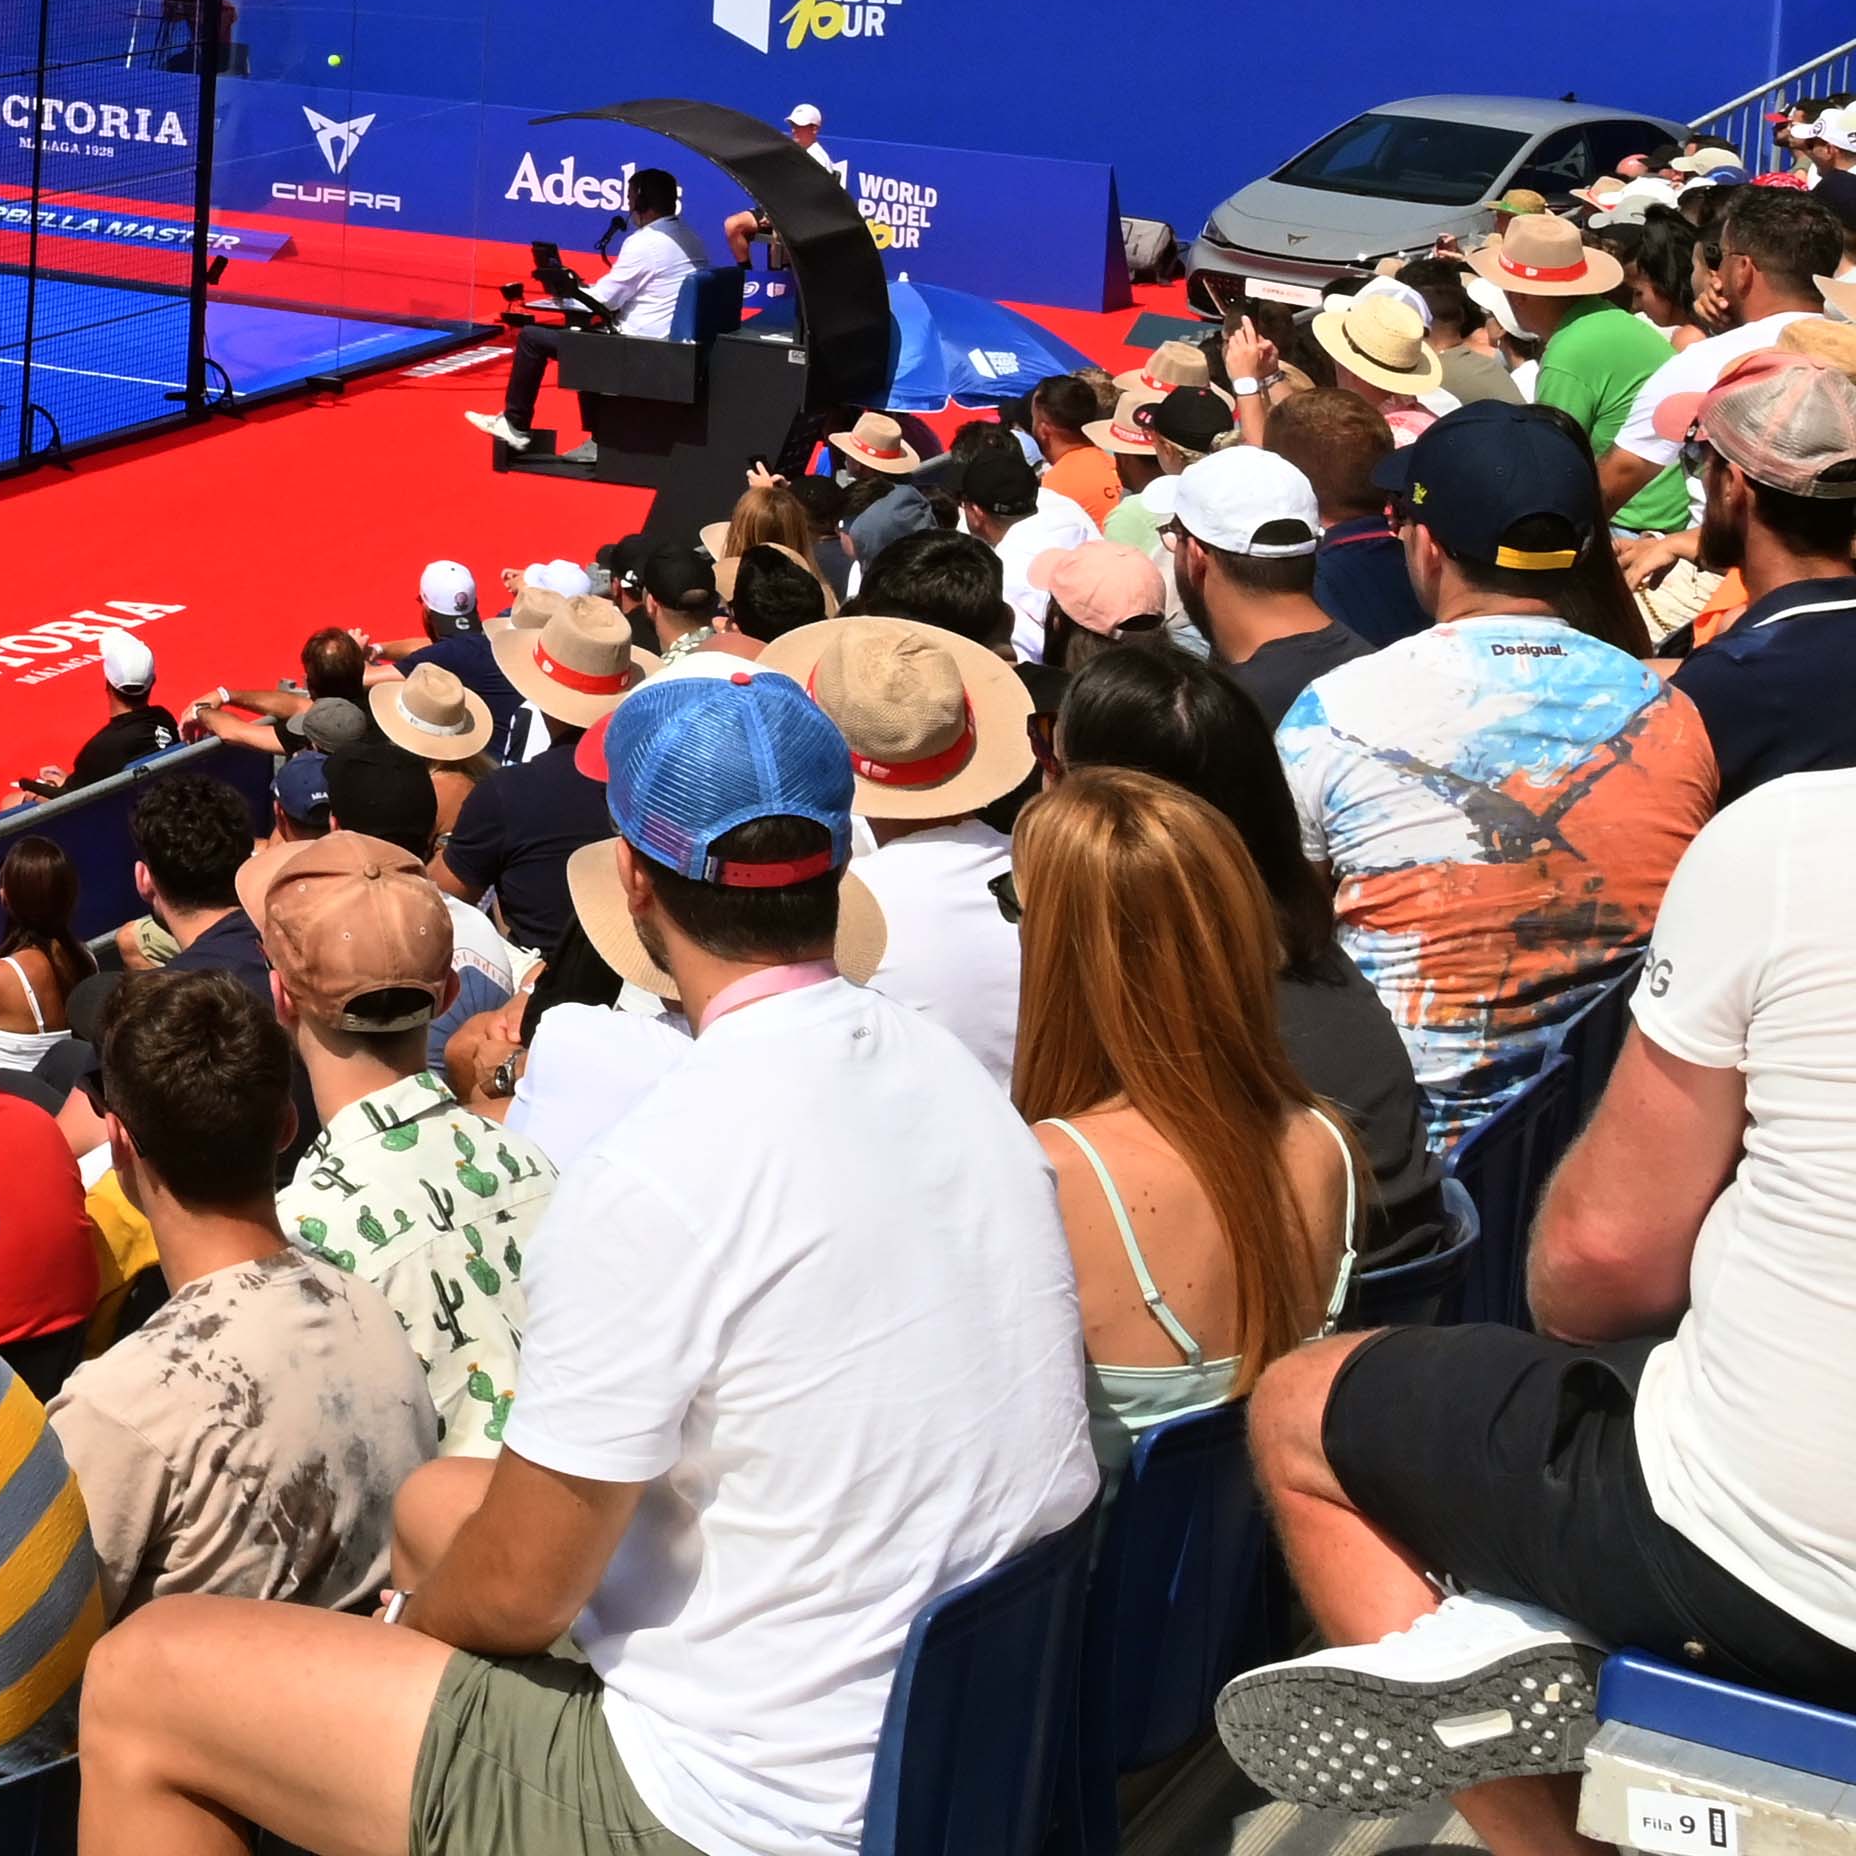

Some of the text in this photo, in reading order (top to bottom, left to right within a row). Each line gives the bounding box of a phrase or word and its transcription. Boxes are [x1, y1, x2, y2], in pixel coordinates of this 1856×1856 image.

[85, 143, 115, 158] 1928
[272, 183, 401, 212] CUPRA
[858, 171, 938, 208] WORLD
[857, 199, 932, 230] PADEL
[105, 222, 241, 251] MASTER
[15, 652, 105, 685] MÁLAGA
[1642, 1816, 1673, 1832] Fila
[1678, 1814, 1696, 1835] 9
